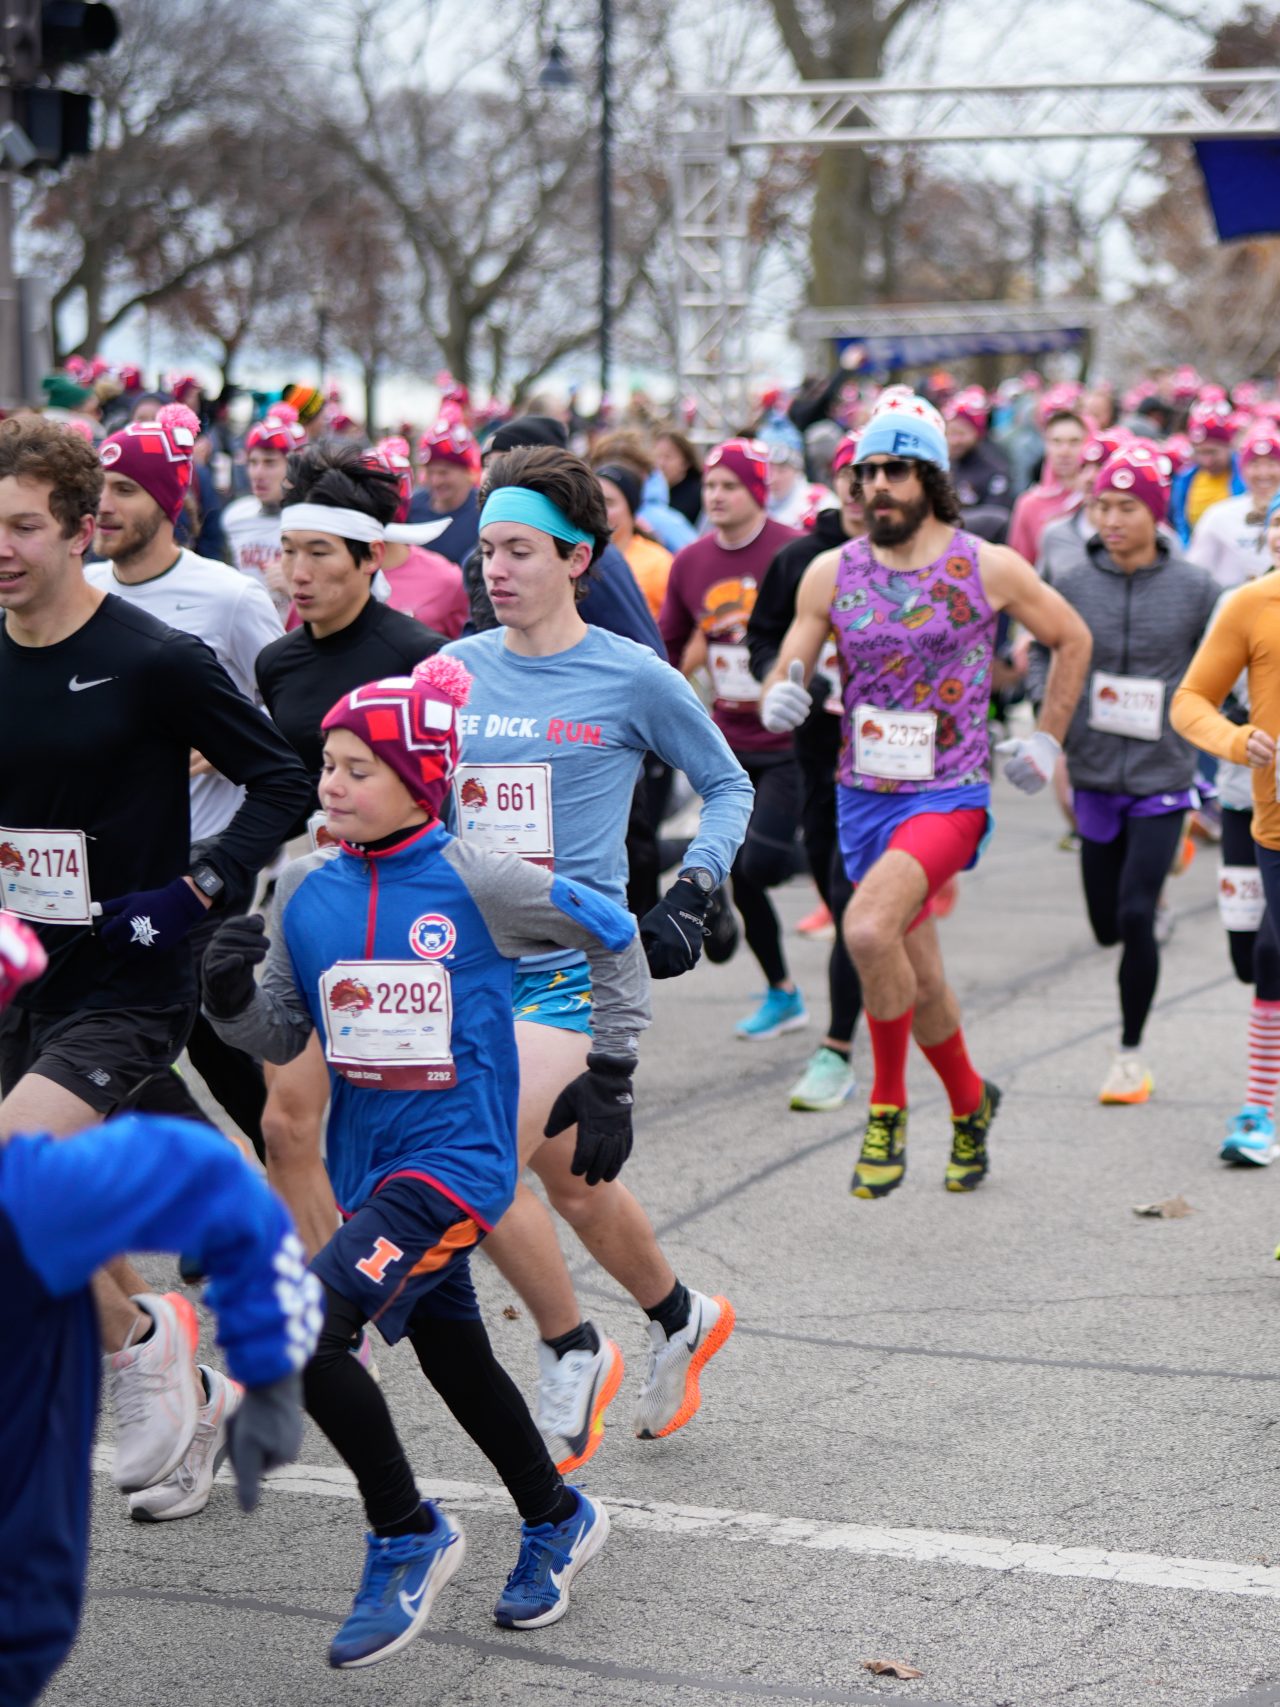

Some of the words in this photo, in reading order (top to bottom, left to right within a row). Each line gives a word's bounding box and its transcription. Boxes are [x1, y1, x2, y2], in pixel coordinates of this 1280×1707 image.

[460, 715, 481, 735] EE
[485, 714, 540, 738] DICK.
[546, 719, 606, 746] RUN.
[887, 724, 930, 746] 2375
[497, 783, 535, 811] 661
[28, 848, 79, 878] 2174
[377, 981, 443, 1014] 2292
[427, 1071, 452, 1081] 2292
